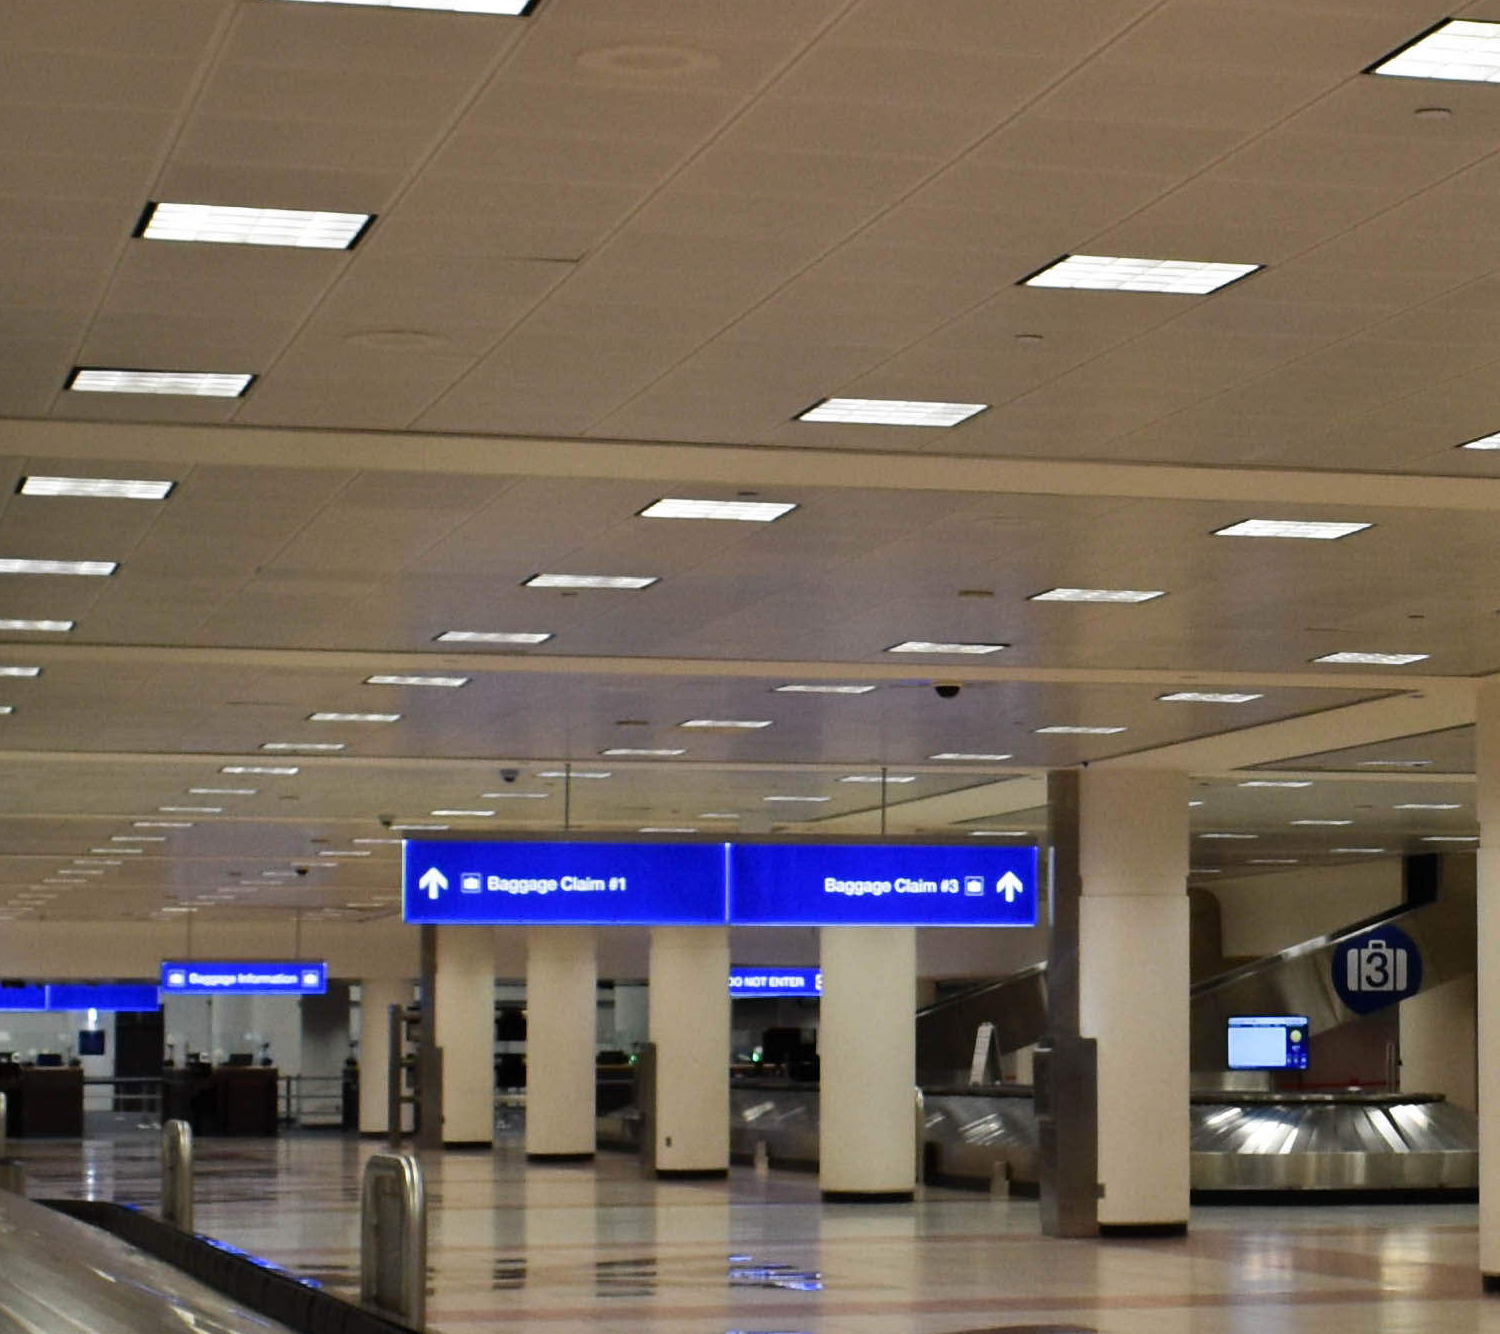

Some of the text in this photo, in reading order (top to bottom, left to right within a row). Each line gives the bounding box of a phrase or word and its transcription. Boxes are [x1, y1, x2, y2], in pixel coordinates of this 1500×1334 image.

[488, 876, 625, 894] Baggage Claim #1
[825, 878, 958, 895] Baggage Claim #3
[1366, 952, 1389, 988] 3
[744, 977, 767, 987] NOT
[769, 977, 804, 987] ENTER
